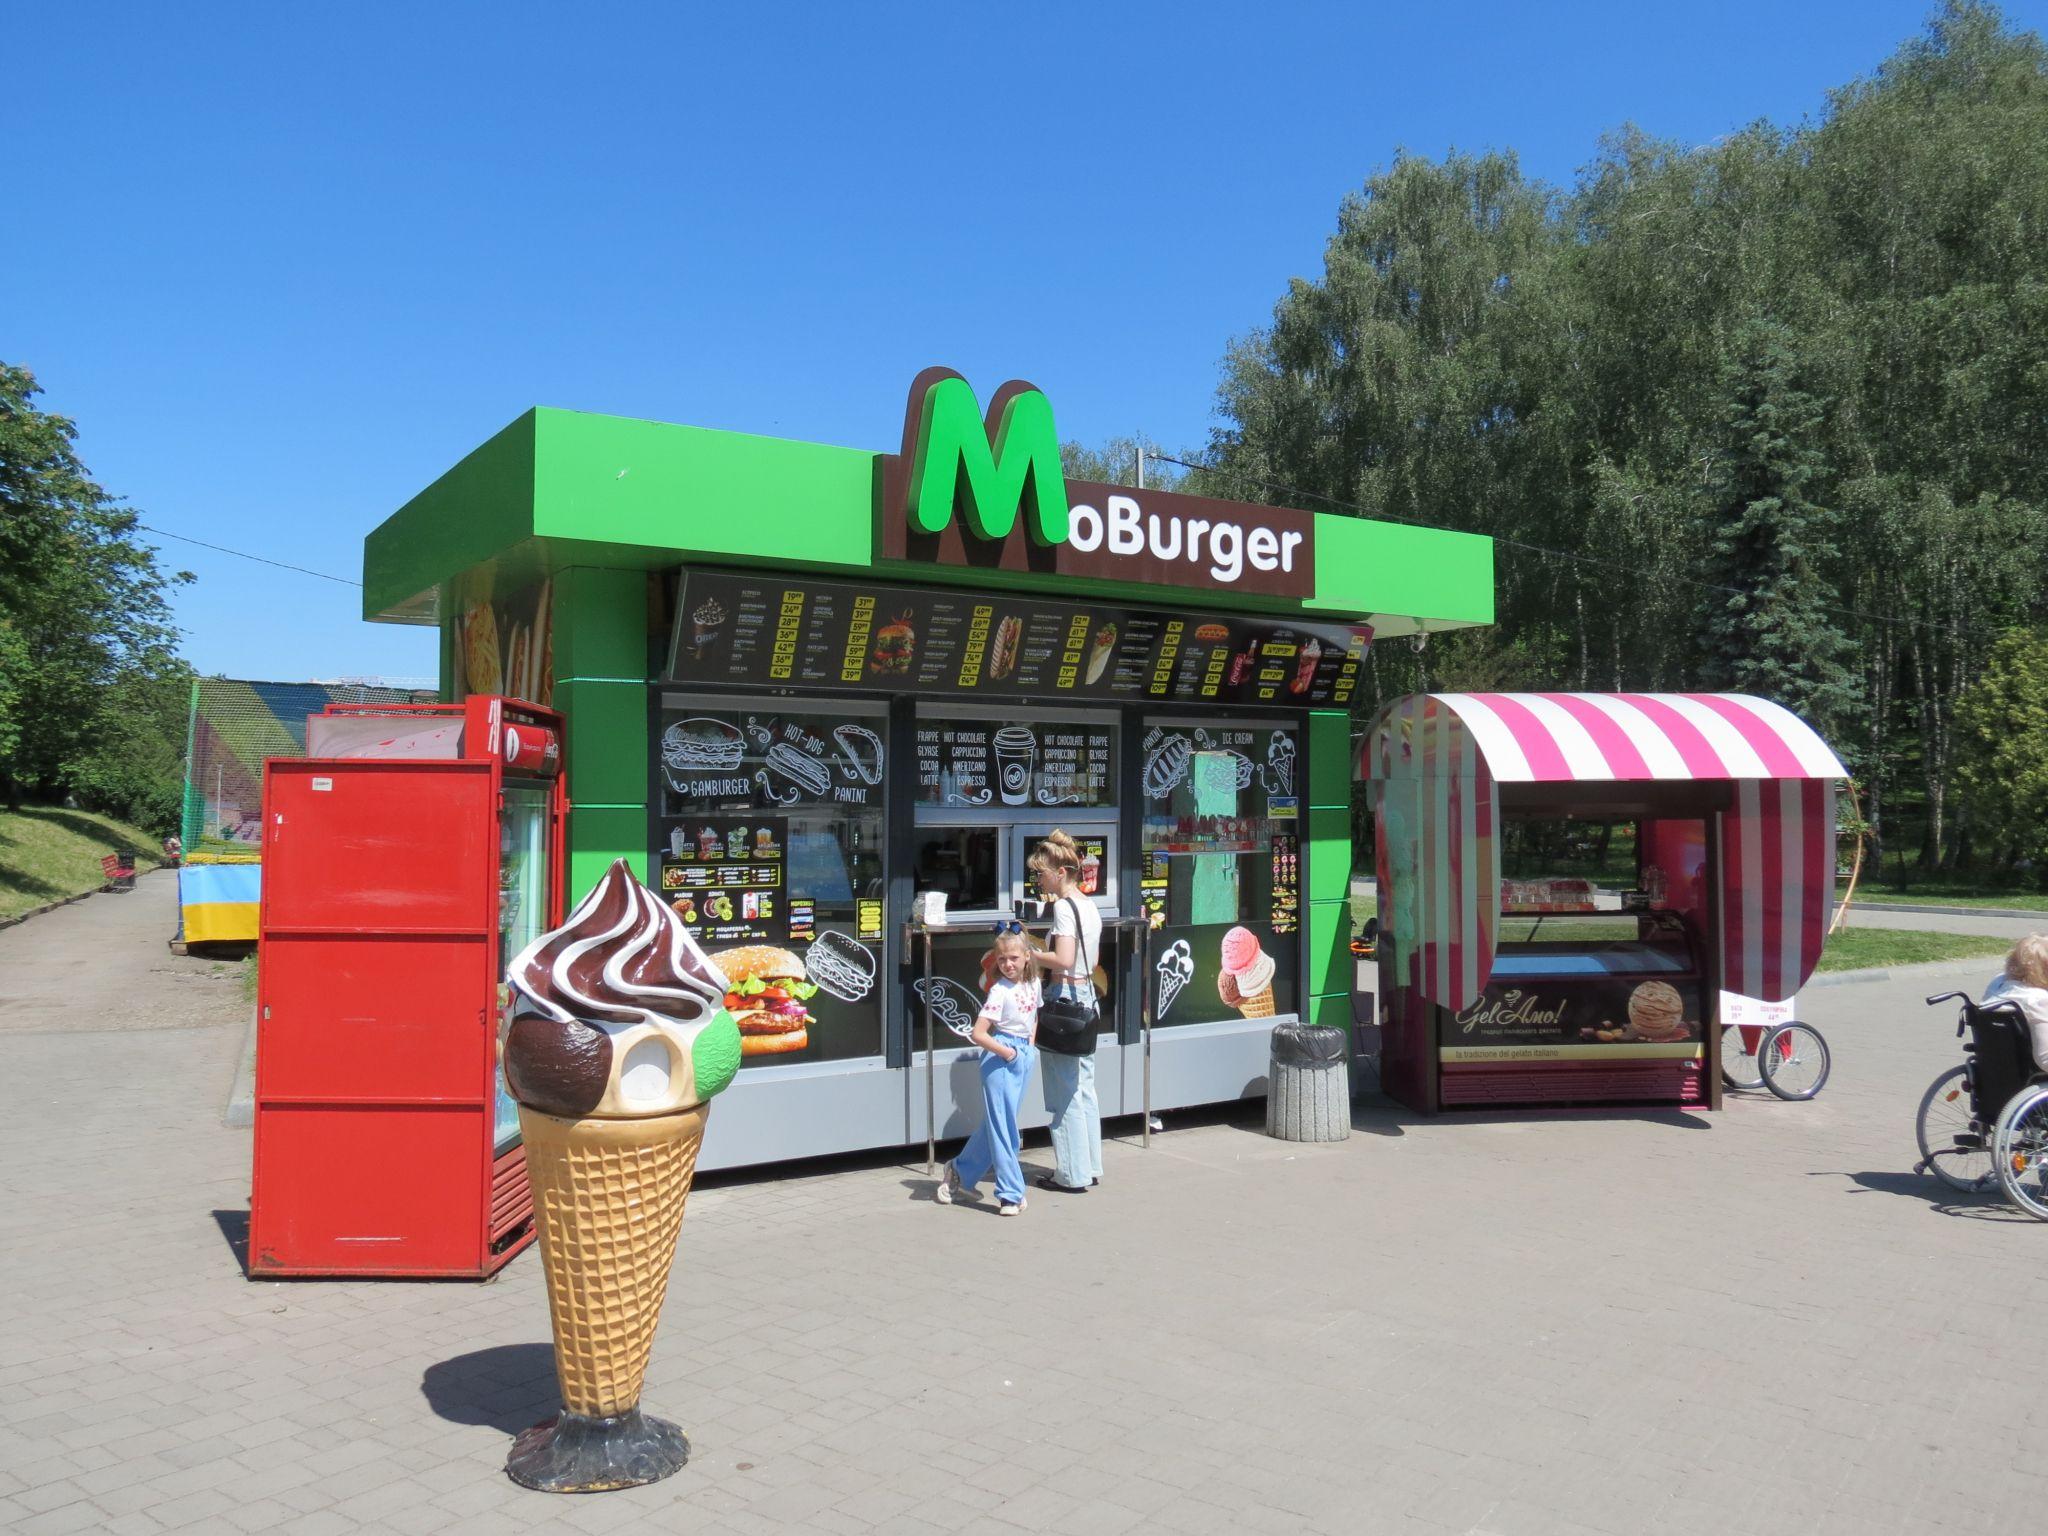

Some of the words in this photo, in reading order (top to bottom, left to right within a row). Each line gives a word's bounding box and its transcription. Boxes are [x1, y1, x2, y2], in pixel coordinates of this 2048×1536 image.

[906, 376, 1303, 584] MoBurger
[785, 723, 825, 755] HOT-DOG
[917, 731, 939, 742] FRAPPE
[943, 732, 954, 743] HOT
[957, 732, 986, 744] CHOCOLATE
[1044, 735, 1055, 745] HOT
[1056, 735, 1084, 747] CHOCOLATE
[1089, 735, 1108, 747] FRAPPE
[1142, 726, 1164, 752] PANINI
[1222, 732, 1232, 744] ICE
[1234, 732, 1254, 745] CREAM
[951, 746, 987, 758] CAPPUCCINO
[1044, 748, 1077, 760] CAPPUCCINO
[920, 760, 939, 771] COCOA
[952, 761, 987, 772] AMERICANO
[1044, 762, 1076, 773] AMERICANO
[1089, 762, 1106, 774] COCOA
[920, 775, 939, 786] LATTE
[957, 775, 986, 786] ESPRESSO
[1044, 776, 1072, 787] ESPRESSO
[1089, 776, 1105, 787] LATTE
[691, 778, 750, 797] GAMBURGER
[834, 787, 867, 803] PANINI
[1455, 1050, 1463, 1058] la
[1464, 1050, 1497, 1058] tradizione
[1511, 1049, 1533, 1059] gelato
[1533, 1049, 1558, 1057] italiano
